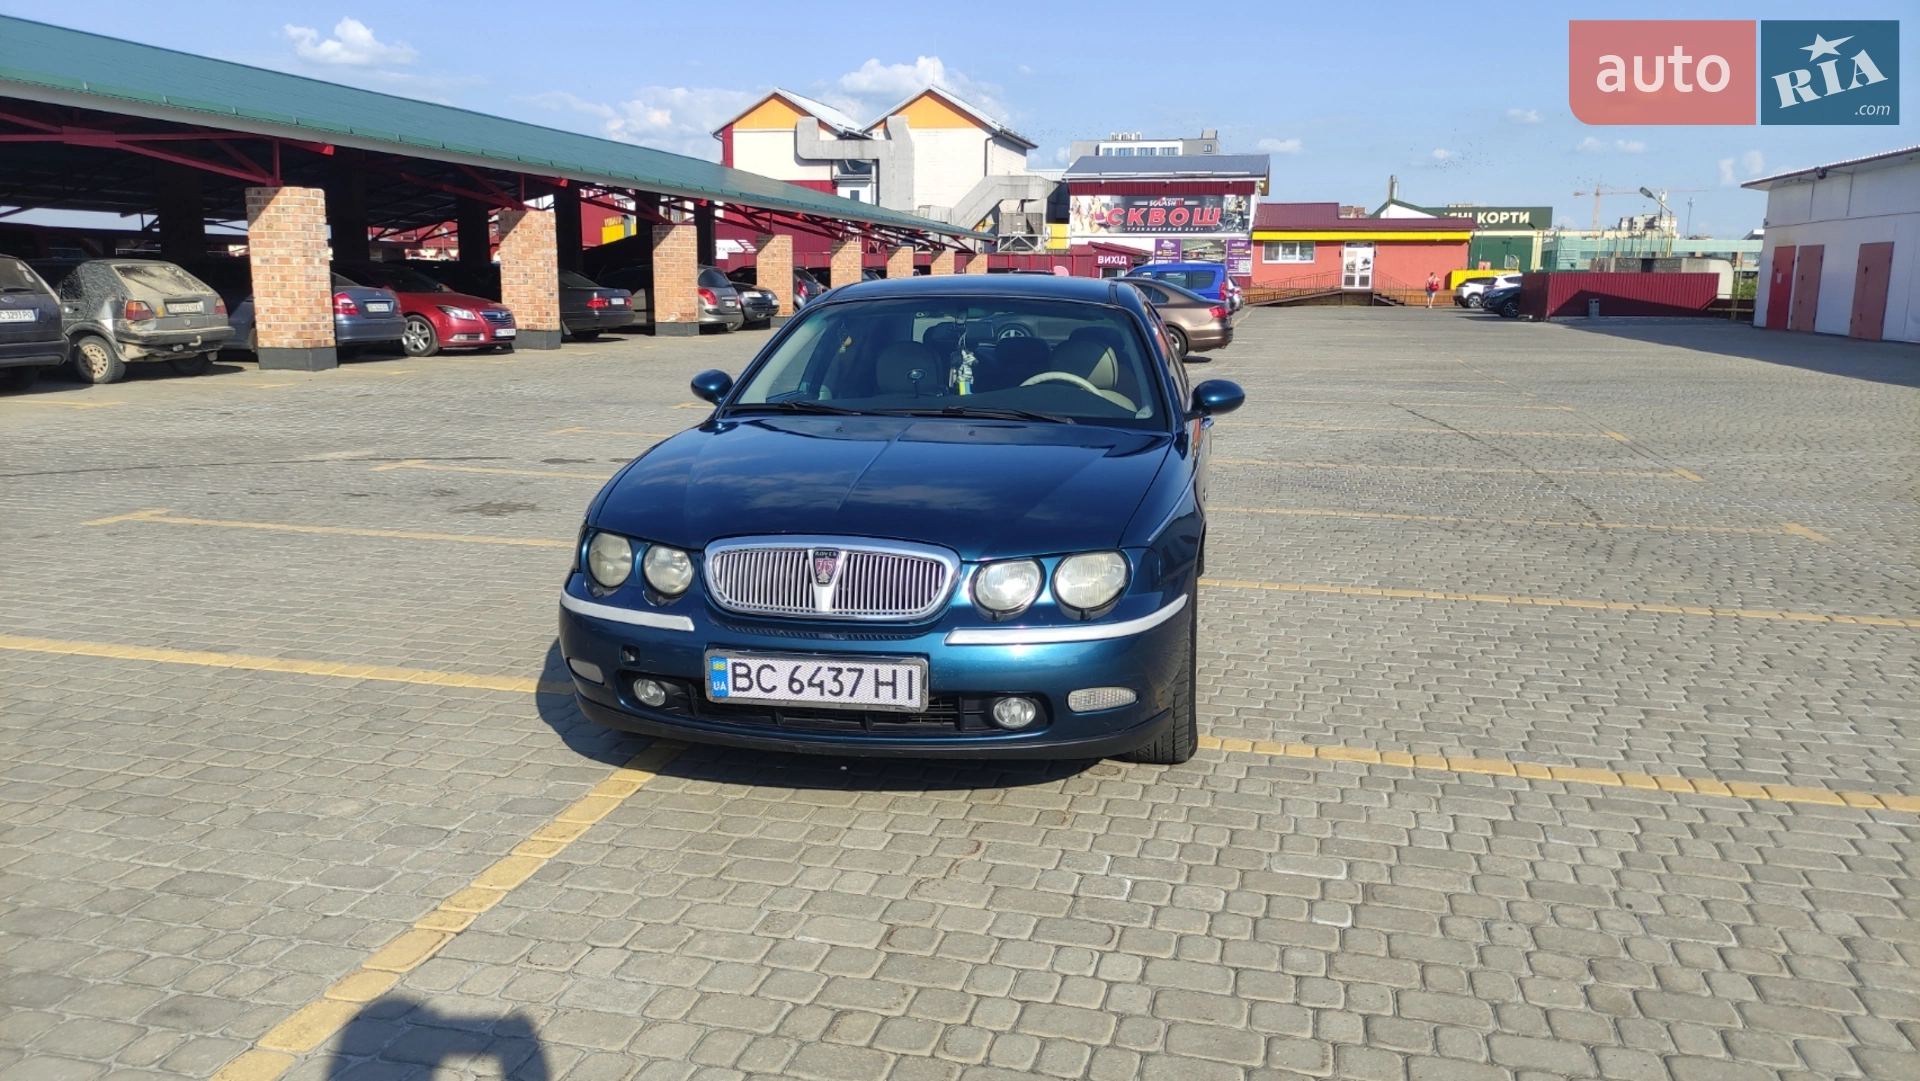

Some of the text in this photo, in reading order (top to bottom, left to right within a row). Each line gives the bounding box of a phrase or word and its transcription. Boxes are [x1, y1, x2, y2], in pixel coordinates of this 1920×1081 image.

[1106, 207, 1221, 227] СКВОШ
[1477, 211, 1530, 224] КОРТИ
[1097, 255, 1127, 265] ВИХІД
[713, 681, 727, 691] UA
[731, 662, 913, 700] BC 6437 HI
